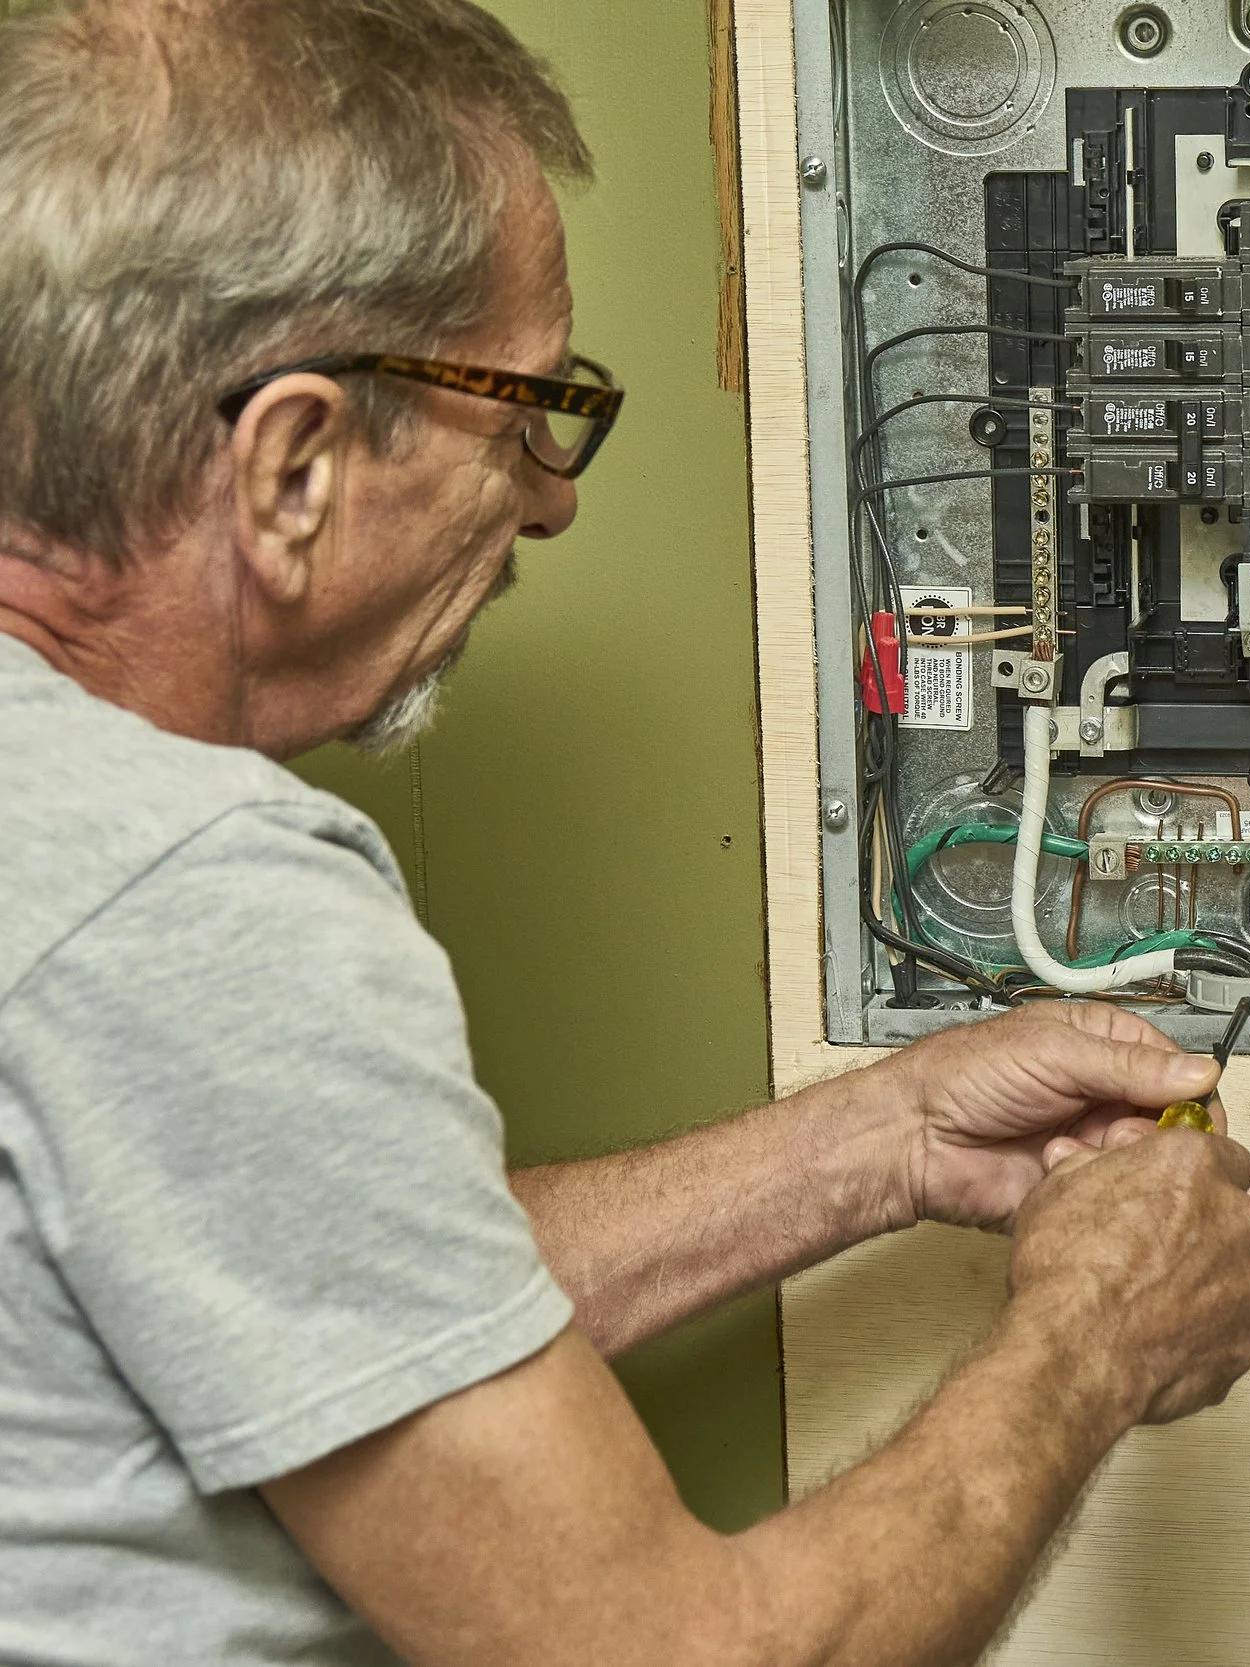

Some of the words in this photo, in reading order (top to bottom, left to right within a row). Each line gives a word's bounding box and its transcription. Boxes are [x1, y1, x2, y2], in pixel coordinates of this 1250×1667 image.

[1185, 292, 1194, 302] 15
[1186, 352, 1194, 362] 15
[1187, 413, 1195, 425] 20
[1187, 472, 1196, 484] 20
[939, 659, 944, 667] TO
[914, 681, 919, 689] OF
[921, 712, 926, 720] 40
